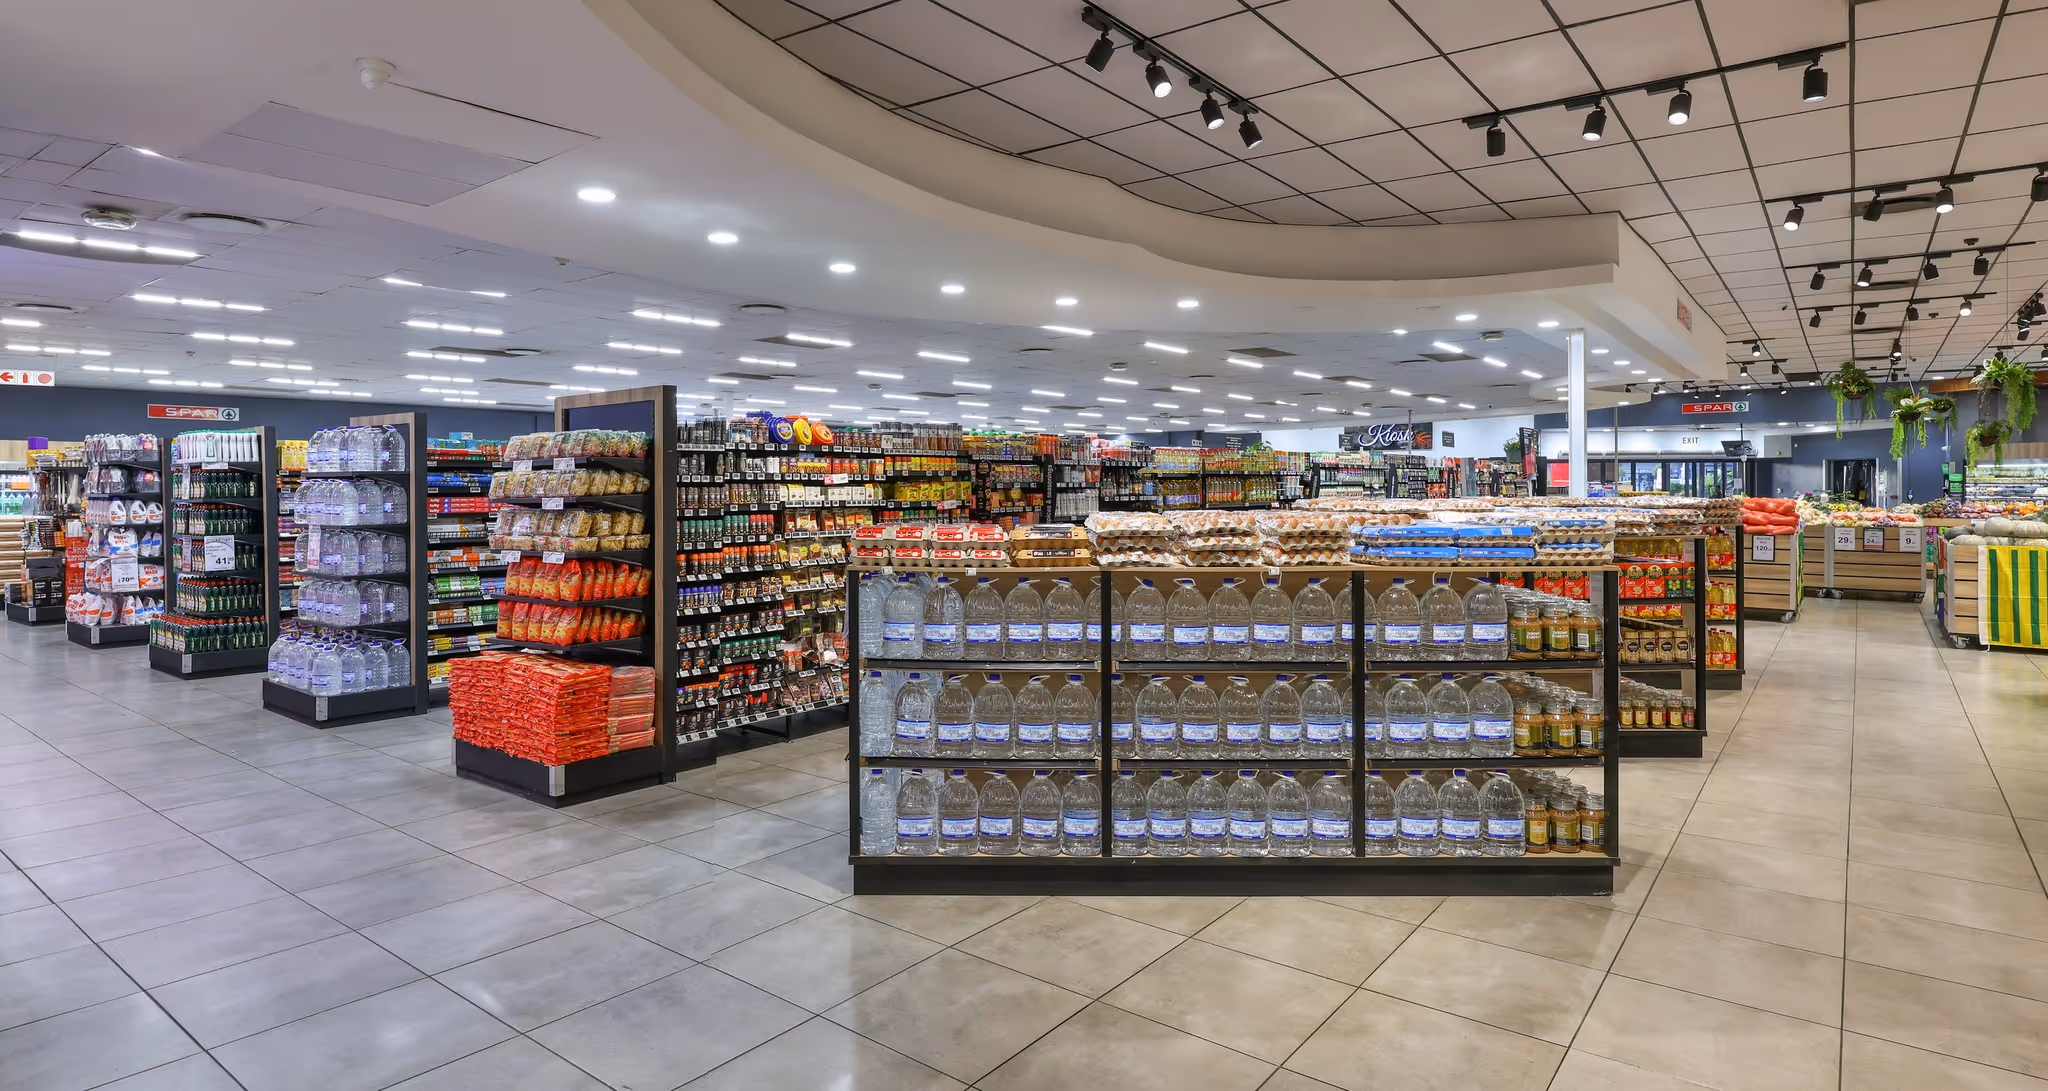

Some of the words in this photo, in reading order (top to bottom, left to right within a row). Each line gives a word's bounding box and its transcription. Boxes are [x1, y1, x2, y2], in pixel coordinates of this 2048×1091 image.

[165, 407, 218, 418] SPAR
[1693, 403, 1732, 412] SPAR
[1358, 424, 1415, 446] Kiosk
